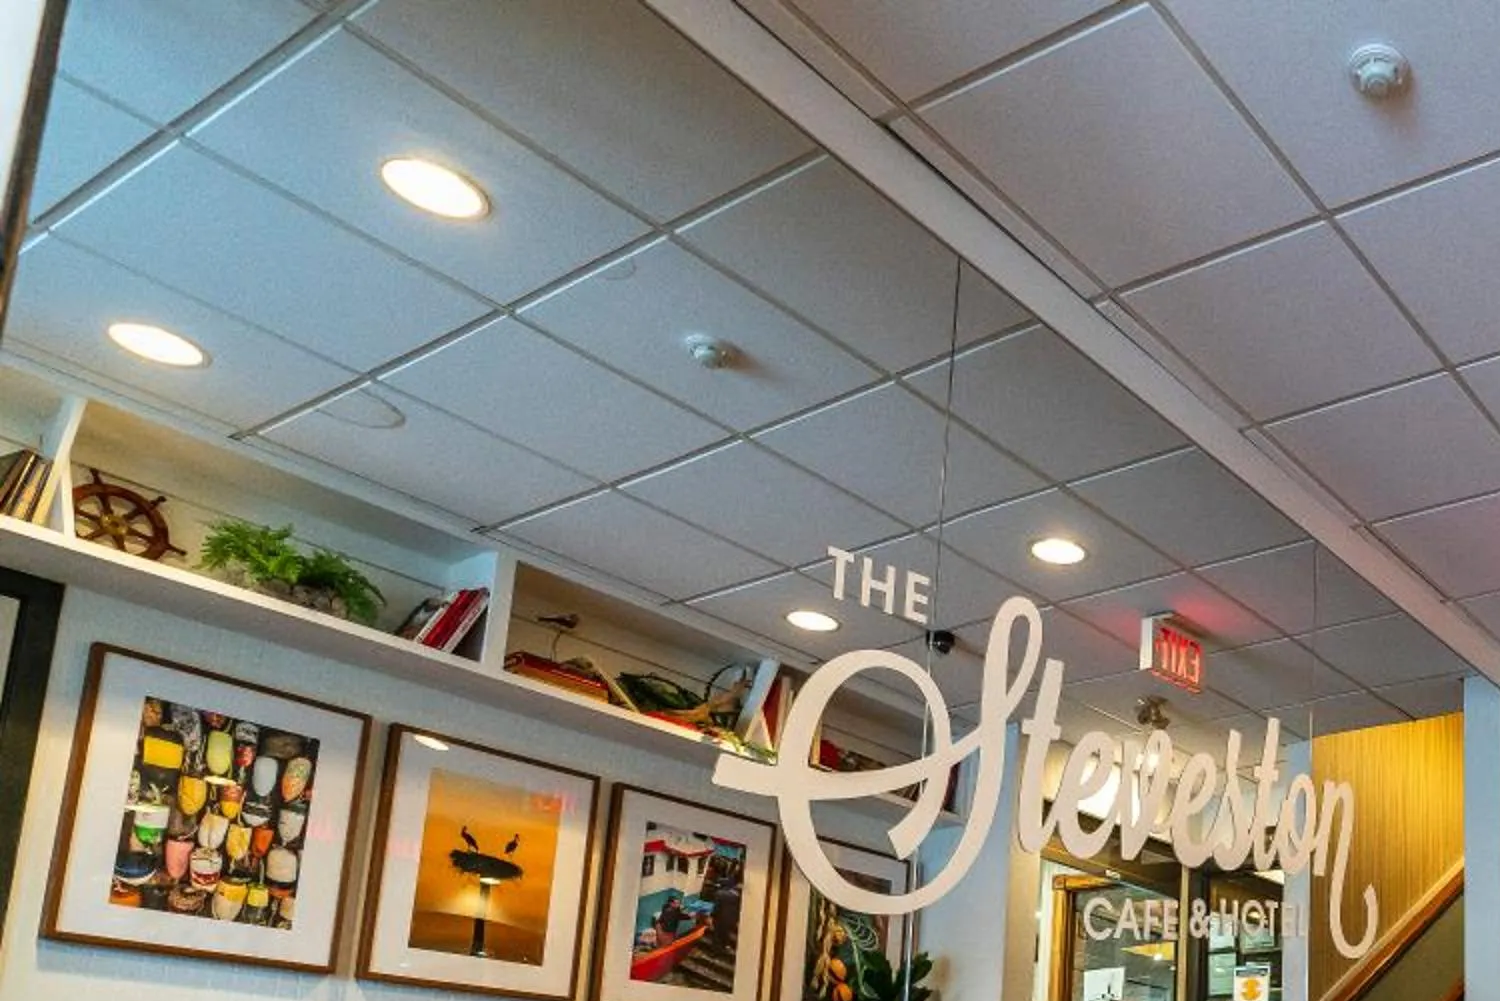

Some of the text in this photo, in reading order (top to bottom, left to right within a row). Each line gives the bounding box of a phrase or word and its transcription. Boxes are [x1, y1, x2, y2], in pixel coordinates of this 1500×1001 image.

[827, 546, 930, 623] THE
[712, 596, 1378, 959] Steveston
[1083, 897, 1305, 941] CAFE & HOTEL
